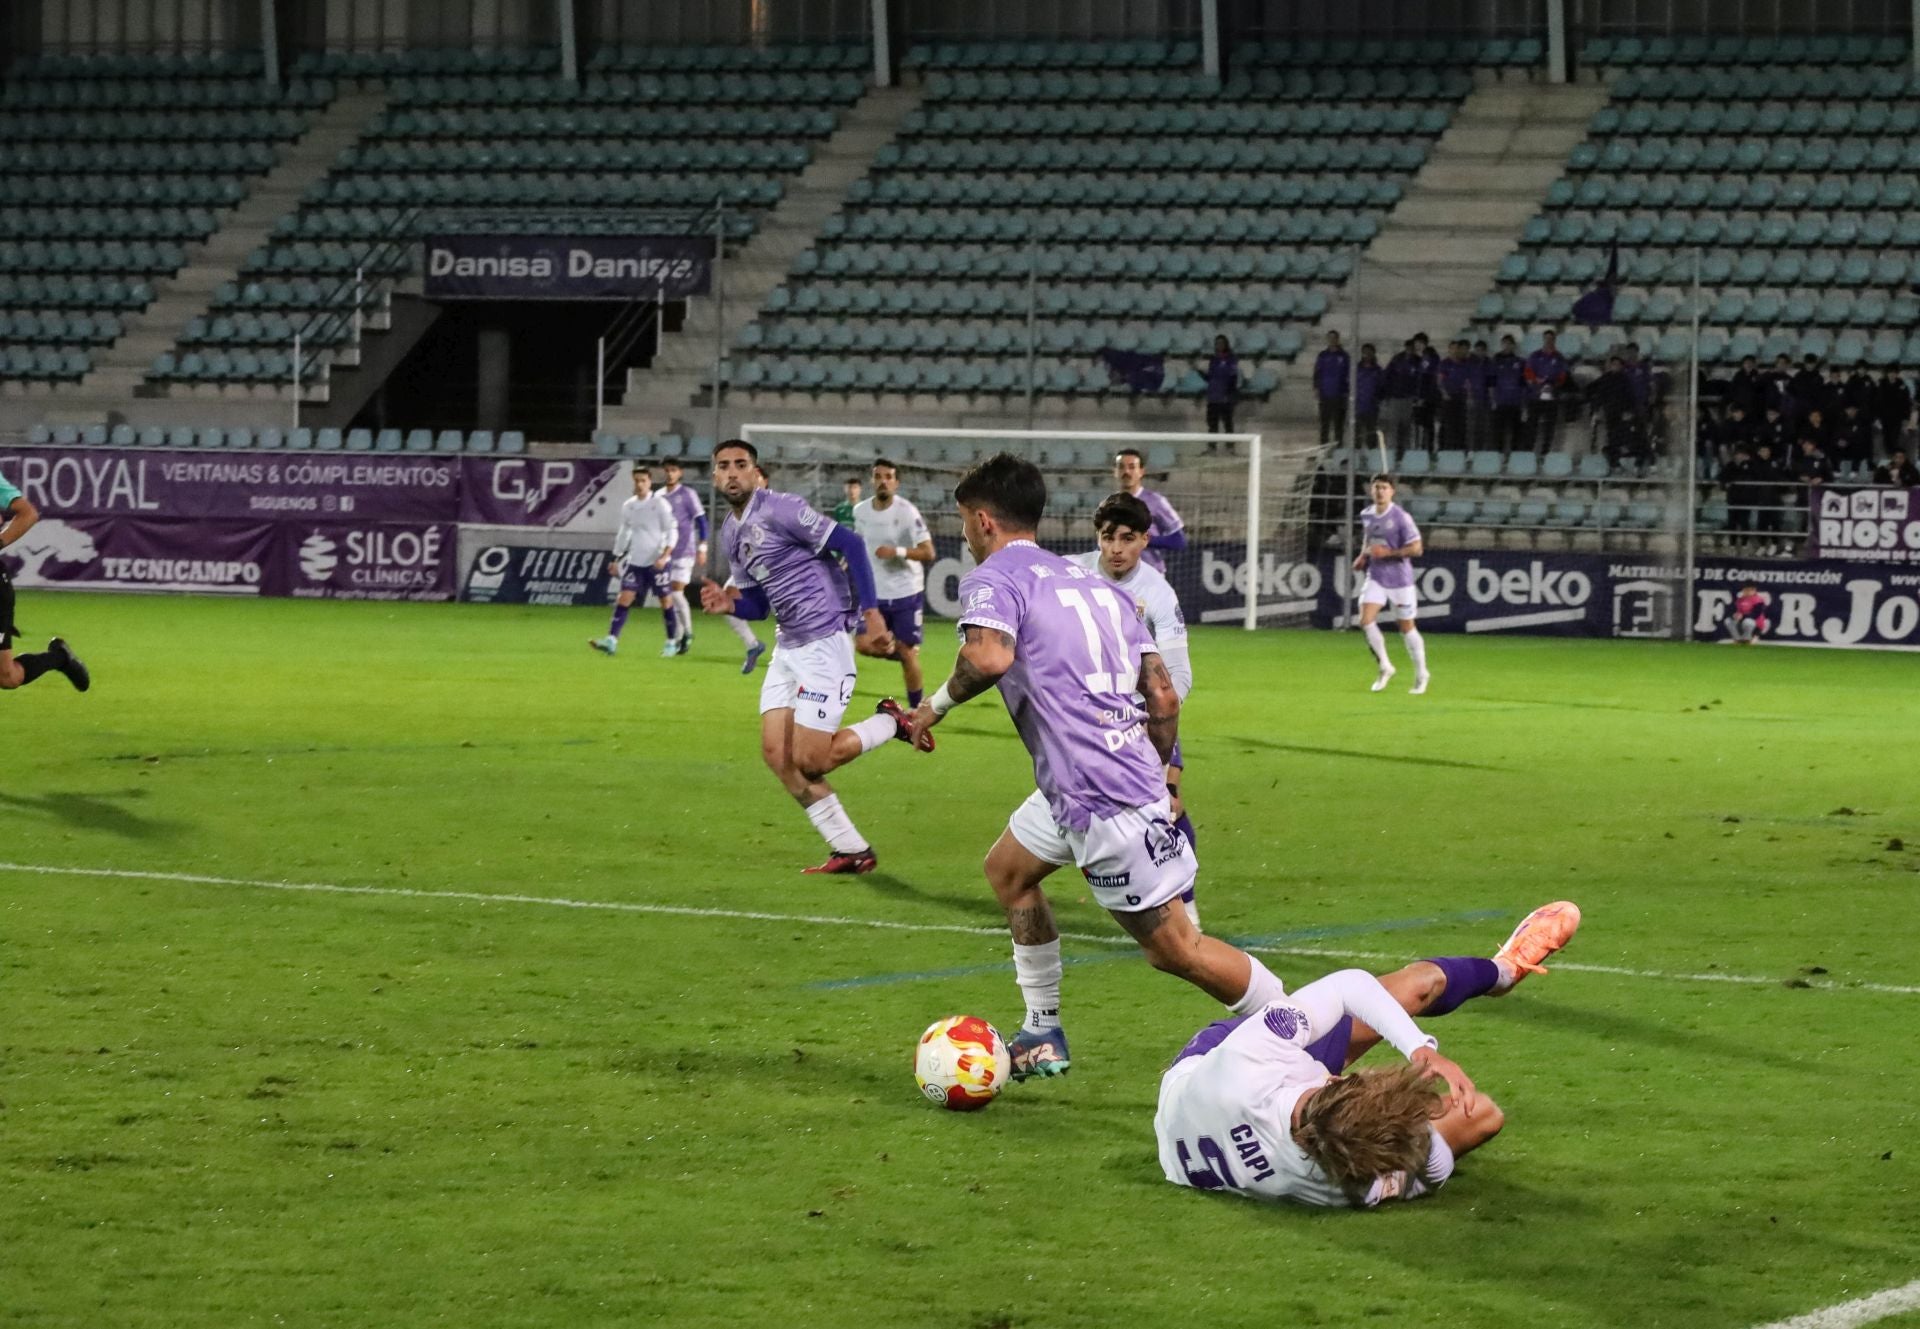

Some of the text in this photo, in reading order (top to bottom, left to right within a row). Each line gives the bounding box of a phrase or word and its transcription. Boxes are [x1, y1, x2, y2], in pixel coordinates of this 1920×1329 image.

[430, 248, 552, 277] Danisa
[0, 455, 160, 509] ROYAL
[161, 463, 262, 484] VENTANAS
[267, 465, 280, 483] &
[346, 525, 442, 567] SILOÉ
[1819, 519, 1898, 549] RIOS
[102, 557, 261, 583] TECNICAMPO
[351, 567, 437, 586] CLÍNICAS
[1466, 558, 1592, 607] beko
[1704, 568, 1724, 581] DE
[1055, 588, 1138, 694] 11
[1125, 894, 1142, 906] b
[1175, 1134, 1239, 1190] 5
[1229, 1123, 1276, 1183] CAPI
